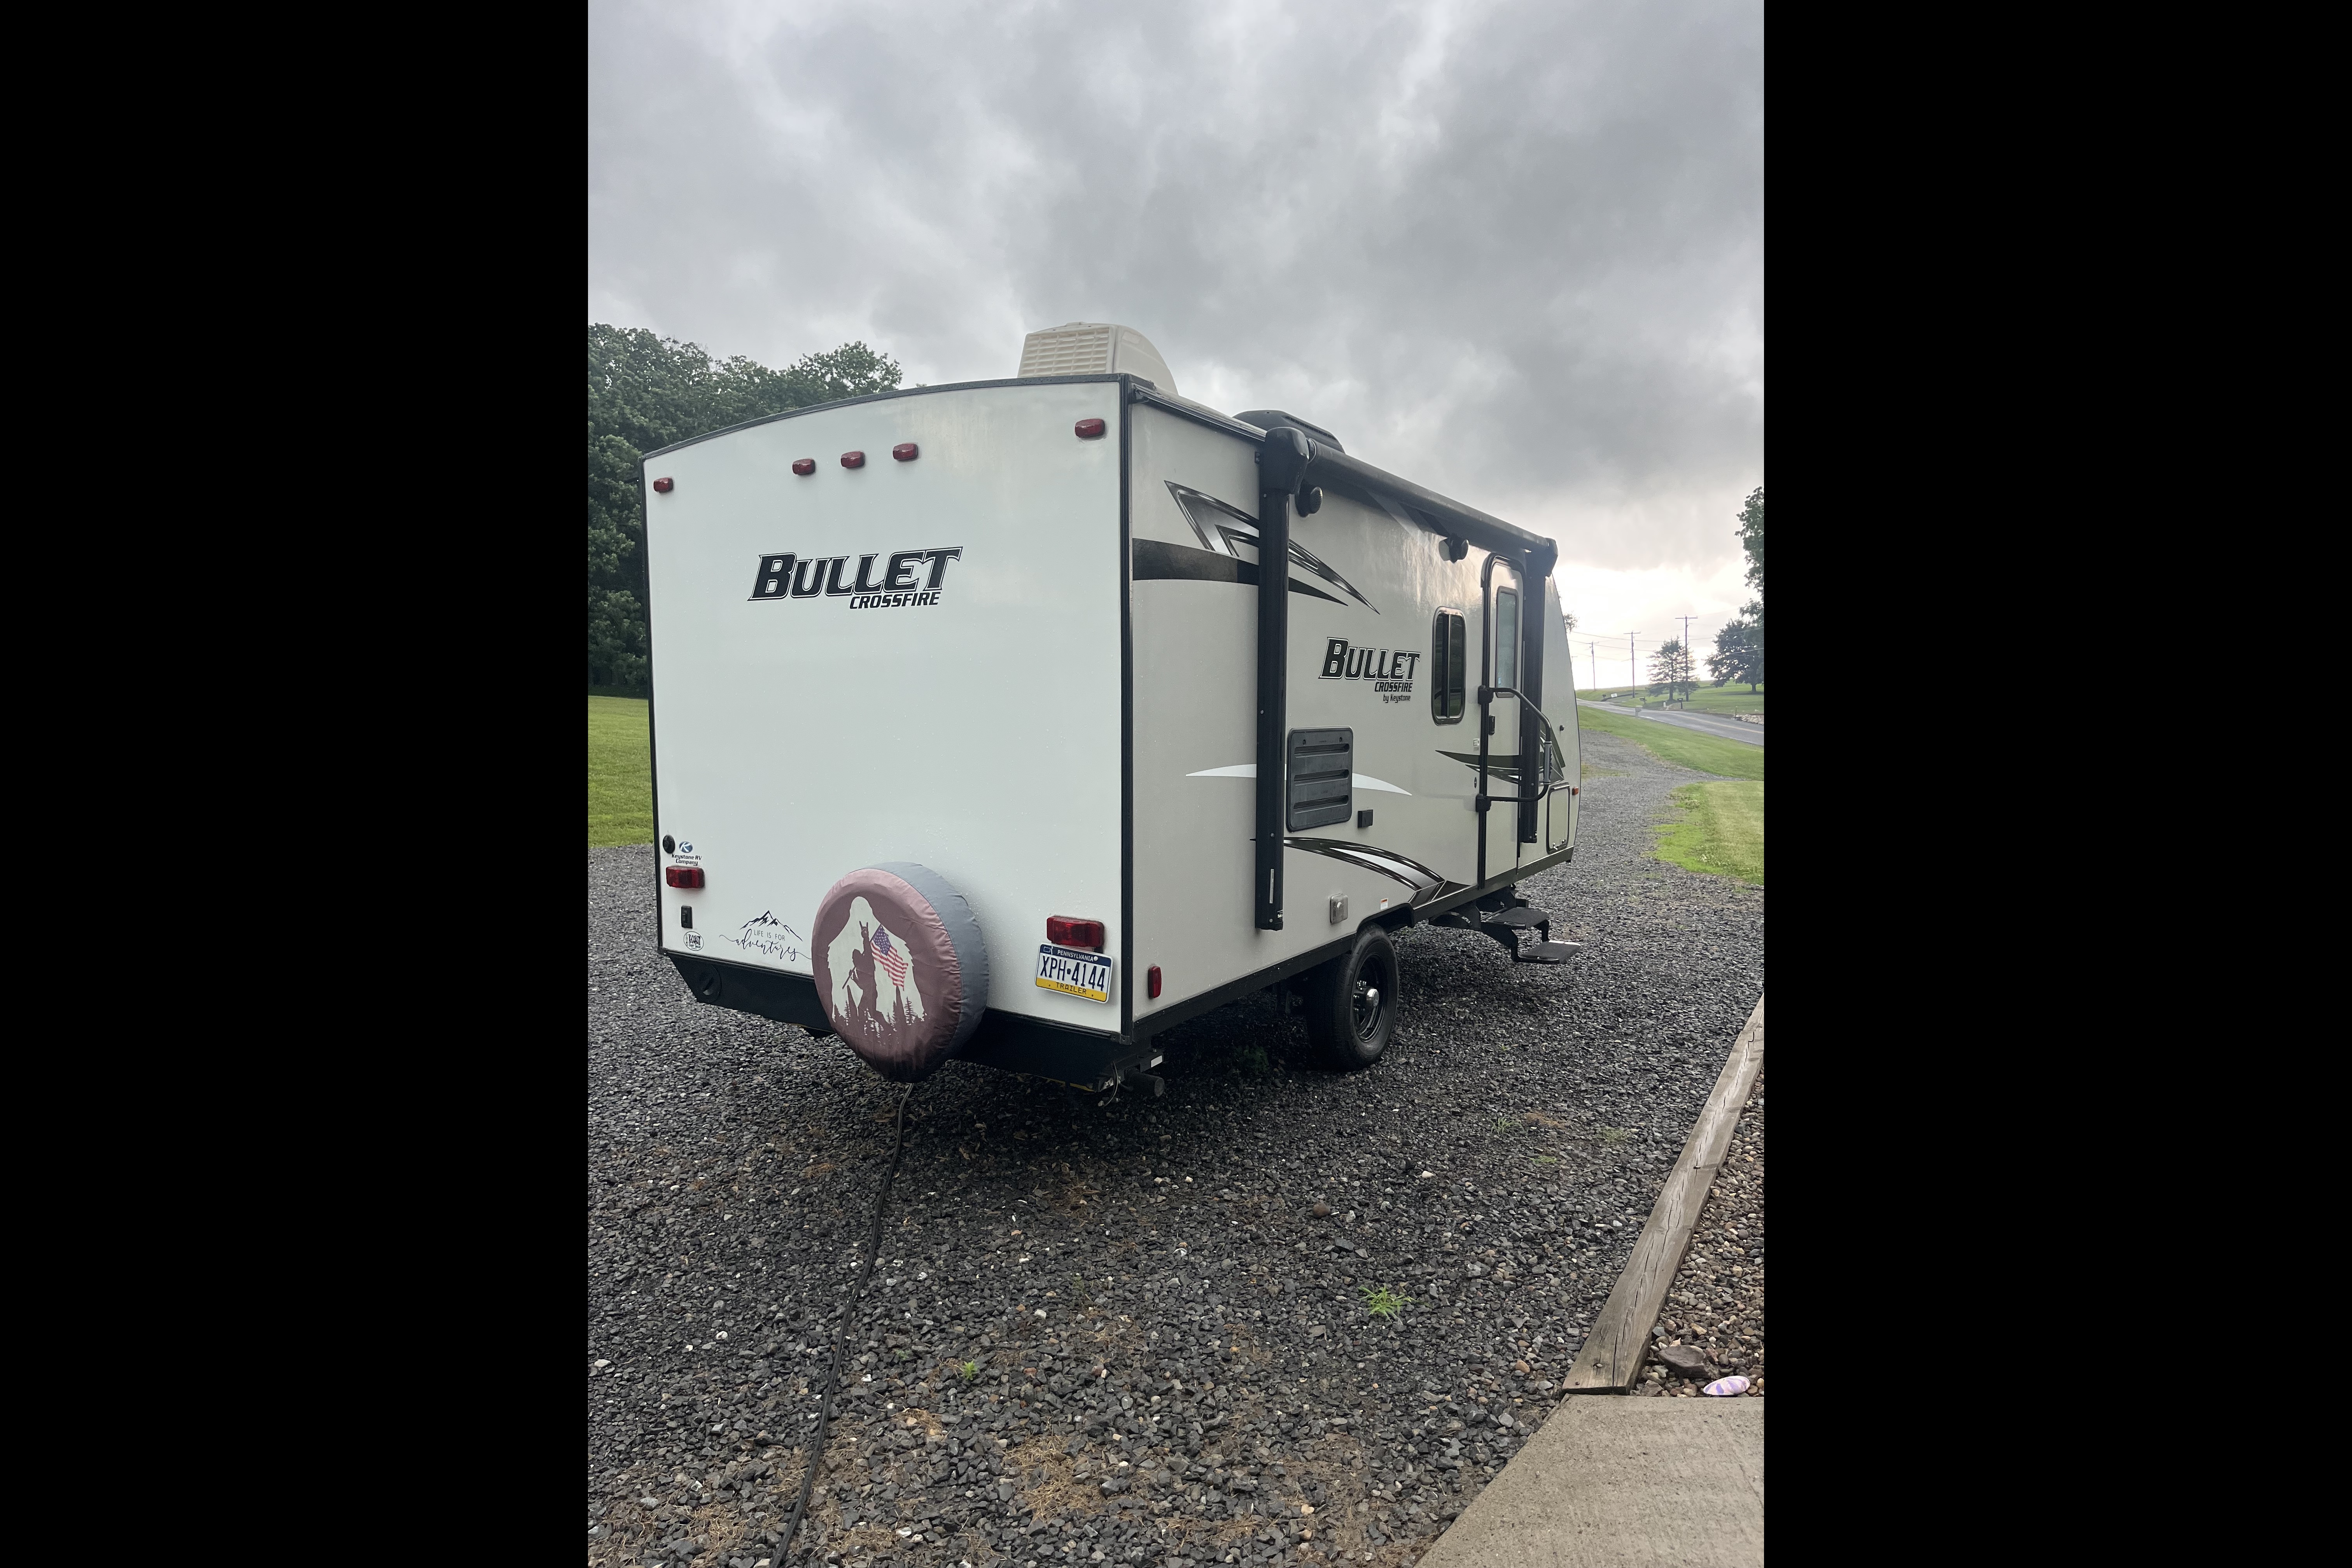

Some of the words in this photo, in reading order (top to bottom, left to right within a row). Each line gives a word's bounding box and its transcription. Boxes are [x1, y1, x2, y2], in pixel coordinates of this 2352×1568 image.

[747, 546, 963, 601] BULLET
[849, 592, 941, 609] CROSSFIRE
[1318, 637, 1421, 681] BULLET
[1374, 682, 1413, 692] CROSSFIRE
[1383, 694, 1389, 703] by
[1390, 694, 1410, 703] Keystone
[1057, 949, 1094, 962] PENNSYLVANIA
[1056, 982, 1086, 994] TRAILER
